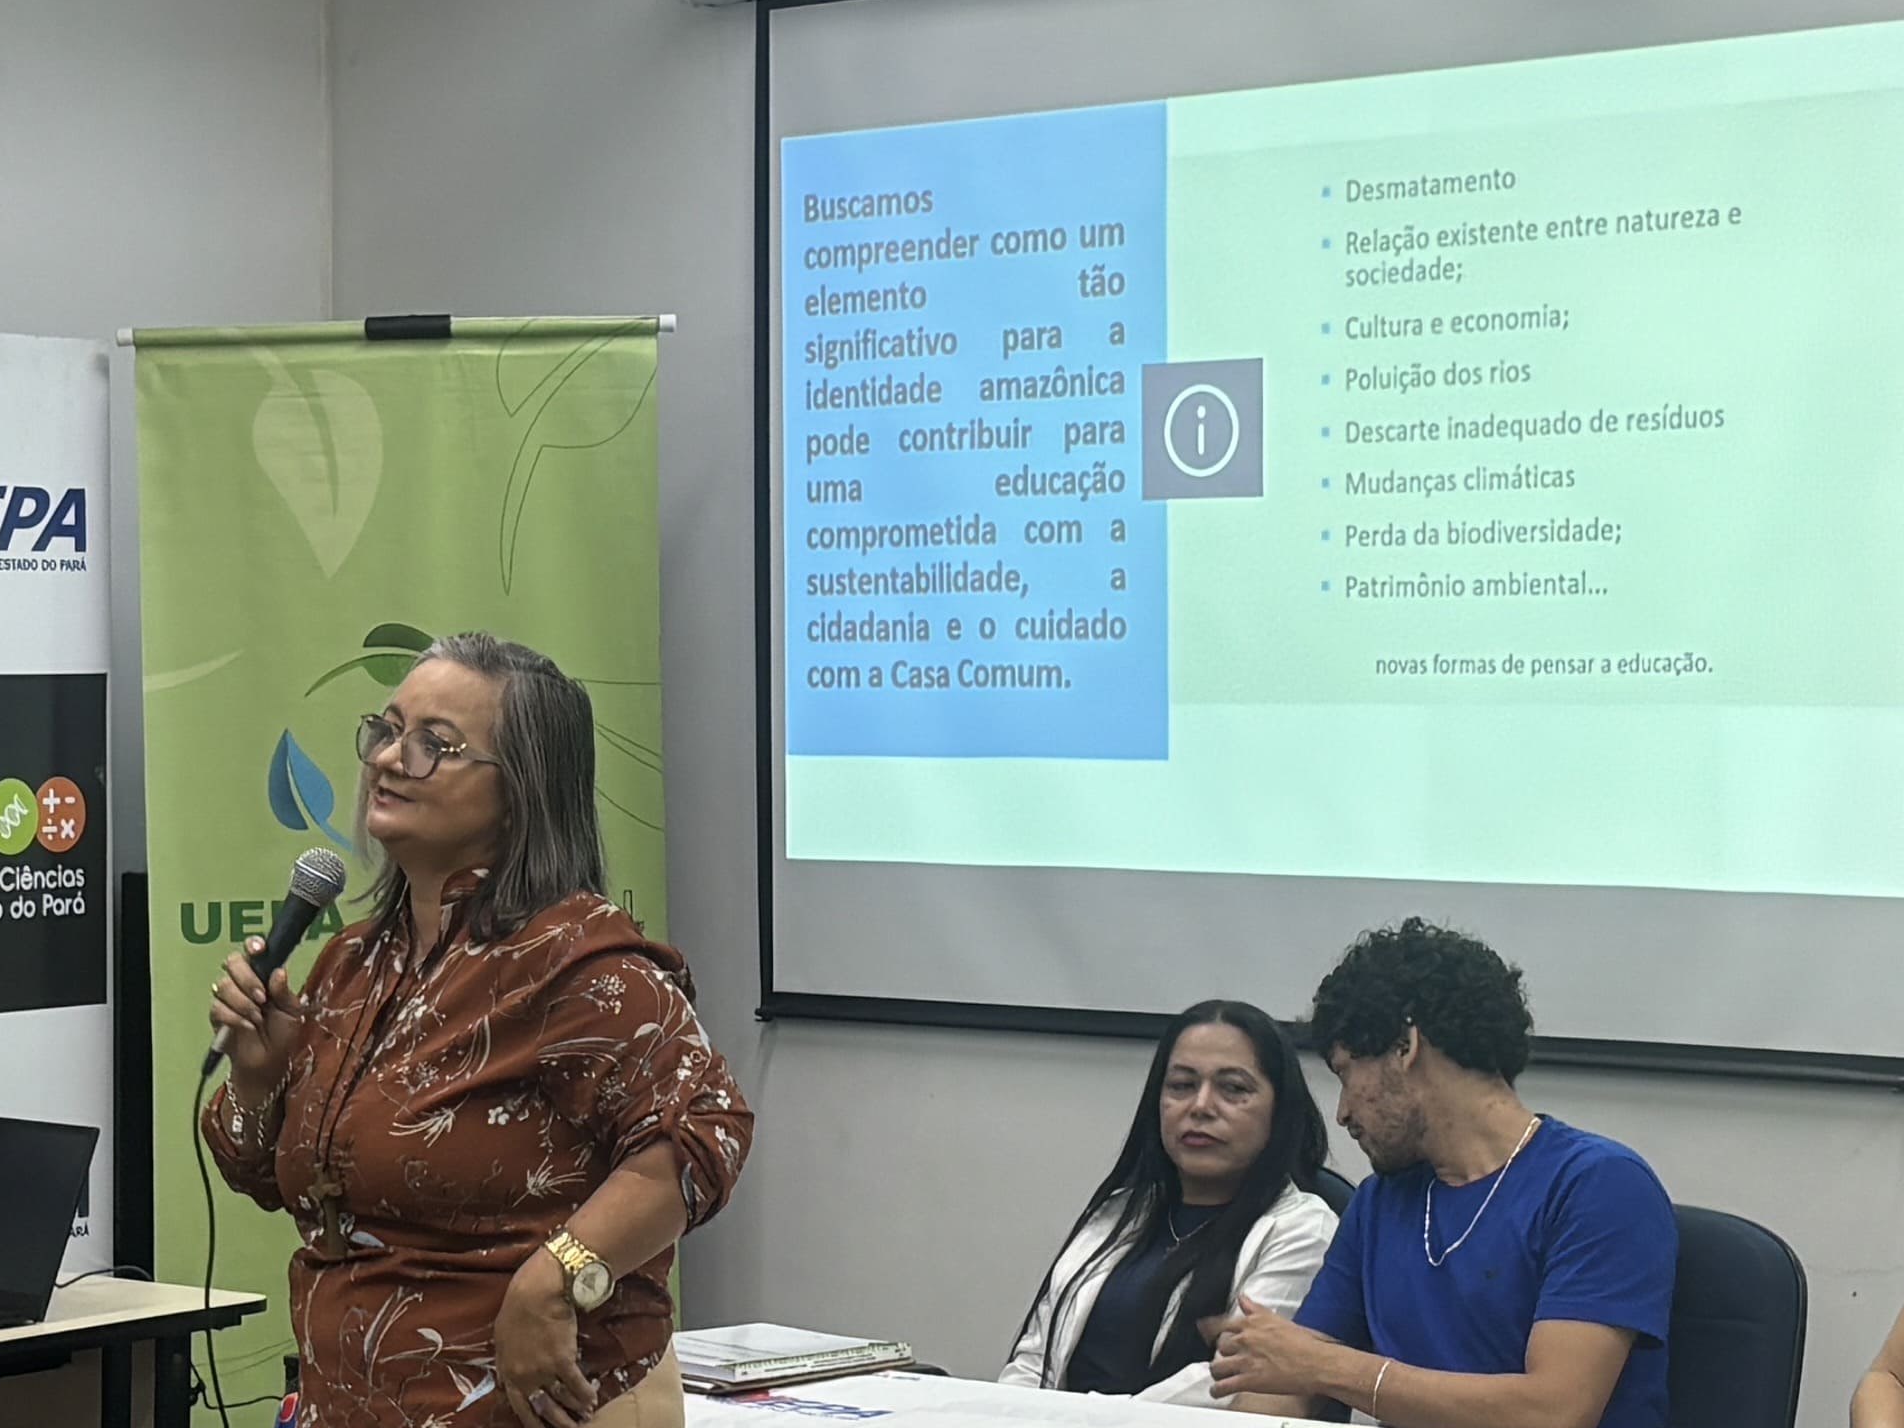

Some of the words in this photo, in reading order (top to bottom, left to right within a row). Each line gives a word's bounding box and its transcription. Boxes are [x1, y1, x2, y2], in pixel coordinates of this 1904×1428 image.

[1346, 168, 1517, 204] Desmatamento
[803, 189, 933, 223] Buscamos
[803, 233, 980, 275] compreender
[990, 227, 1067, 256] como
[1079, 222, 1125, 249] um
[1345, 224, 1430, 257] Relação
[1436, 219, 1539, 248] existente
[1545, 215, 1608, 240] entre
[1615, 208, 1720, 234] natureza
[1727, 206, 1742, 226] e
[804, 281, 927, 317] elemento
[1077, 263, 1125, 298] tão
[1345, 255, 1463, 288] sociedade;
[1344, 313, 1424, 340] Cultura
[1430, 312, 1443, 334] e
[1450, 303, 1570, 334] economia;
[804, 325, 958, 371] significativo
[1002, 325, 1062, 361] para
[1108, 321, 1125, 346] a
[805, 371, 943, 411] identidade
[979, 364, 1125, 402] amazônica
[1345, 362, 1437, 395] Poluição
[1442, 360, 1483, 387] dos
[1489, 359, 1532, 384] rios
[806, 423, 870, 466] pode
[898, 416, 1033, 453] contribuir
[1064, 420, 1126, 455] para
[1345, 419, 1440, 444] Descarte
[1447, 409, 1582, 443] inadequado
[1589, 408, 1619, 434] de
[1626, 402, 1725, 432] resíduos
[806, 479, 862, 504] uma
[994, 460, 1126, 503] educação
[1345, 469, 1458, 499] Mudanças
[1463, 463, 1576, 492] climáticas
[806, 512, 997, 557] comprometida
[1024, 519, 1083, 545] com
[1110, 518, 1126, 542] a
[1345, 522, 1407, 548] Perda
[1413, 520, 1440, 546] da
[1447, 516, 1622, 545] biodiversidade;
[806, 559, 1029, 599] sustentabilidade,
[1110, 567, 1126, 591] a
[1345, 571, 1466, 599] Patrimônio
[1472, 569, 1608, 597] ambiental...
[806, 609, 930, 643] cidadania
[946, 617, 962, 641] e
[978, 616, 996, 640] o
[1014, 607, 1127, 641] cuidado
[806, 665, 861, 689] com
[868, 662, 883, 687] a
[890, 659, 950, 690] Casa
[957, 658, 1071, 689] Comum.
[1375, 658, 1428, 675] novas
[1432, 653, 1497, 675] formas
[1501, 653, 1525, 675] de
[1530, 657, 1595, 678] pensar
[1600, 658, 1612, 675] a
[1617, 651, 1714, 677] educação.
[180, 900, 346, 945] UEA
